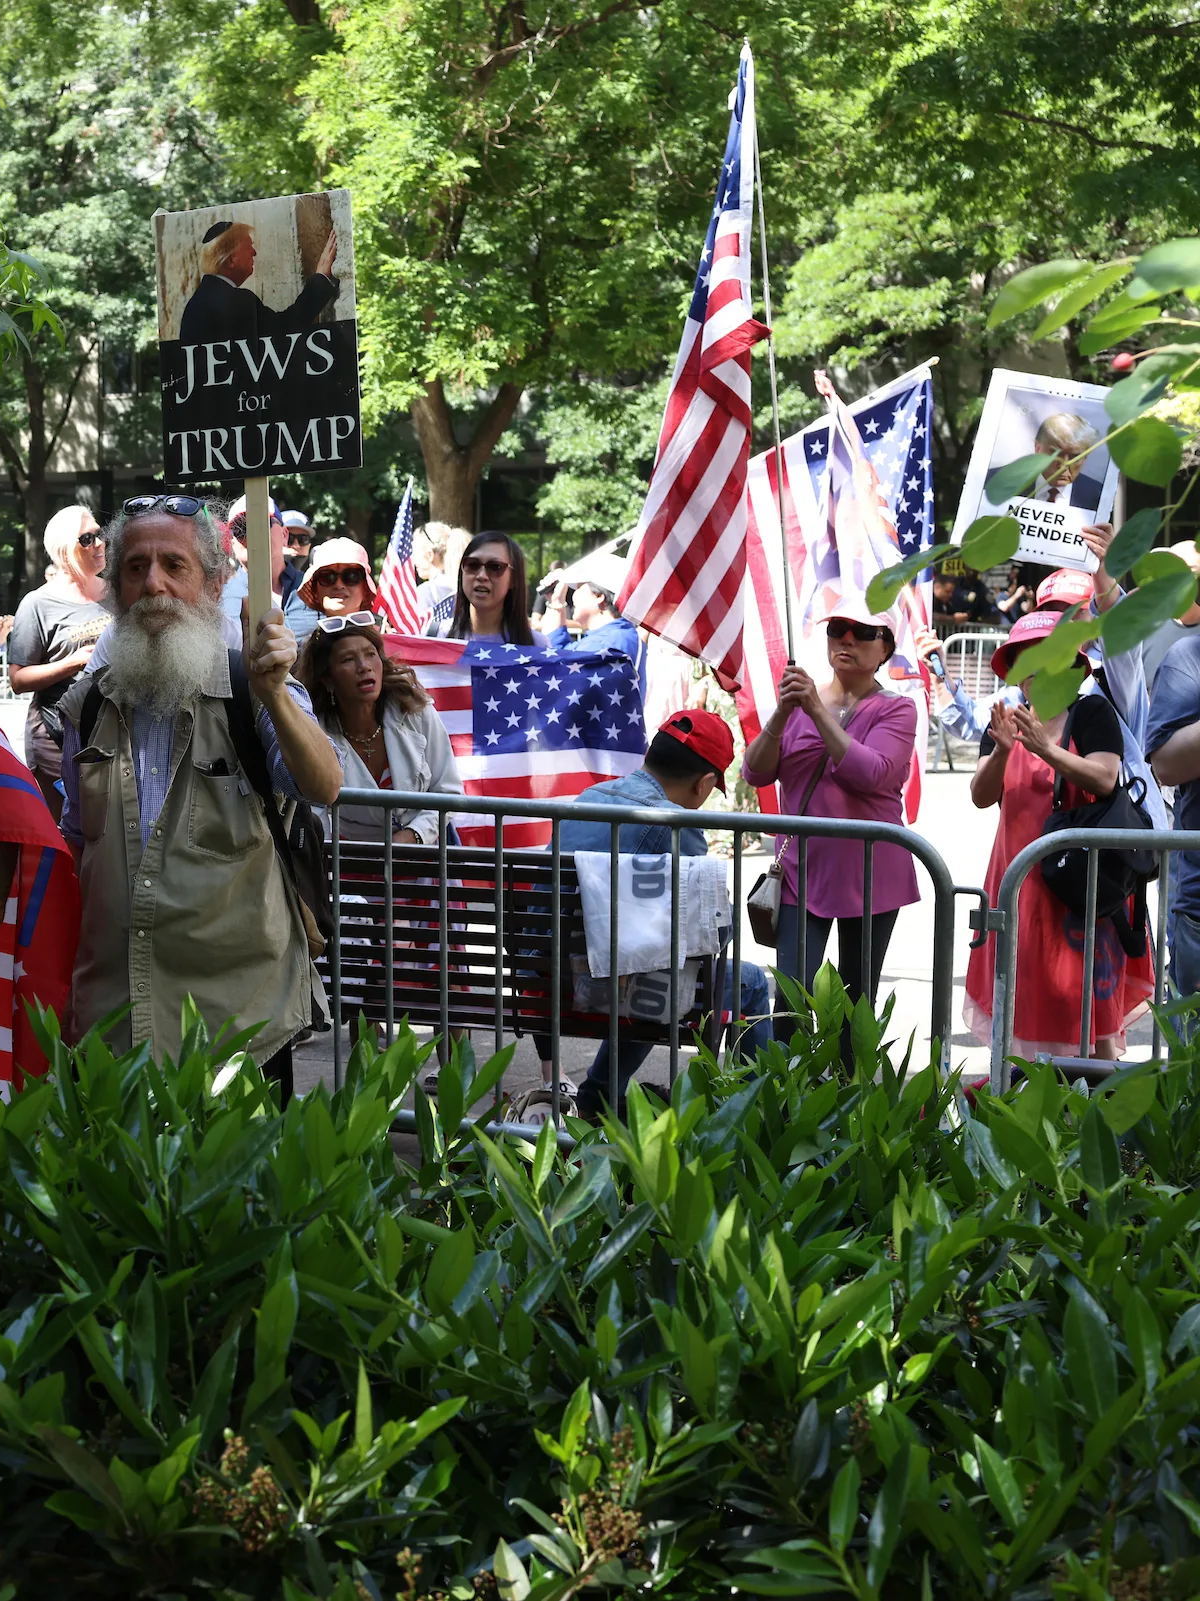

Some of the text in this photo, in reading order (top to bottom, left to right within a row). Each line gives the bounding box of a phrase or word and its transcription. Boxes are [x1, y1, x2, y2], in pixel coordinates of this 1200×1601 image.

[175, 329, 335, 404] JEWS
[237, 390, 271, 412] for
[168, 414, 356, 476] TRUMP
[1008, 504, 1065, 526] NEVER
[1019, 523, 1085, 547] RENDER
